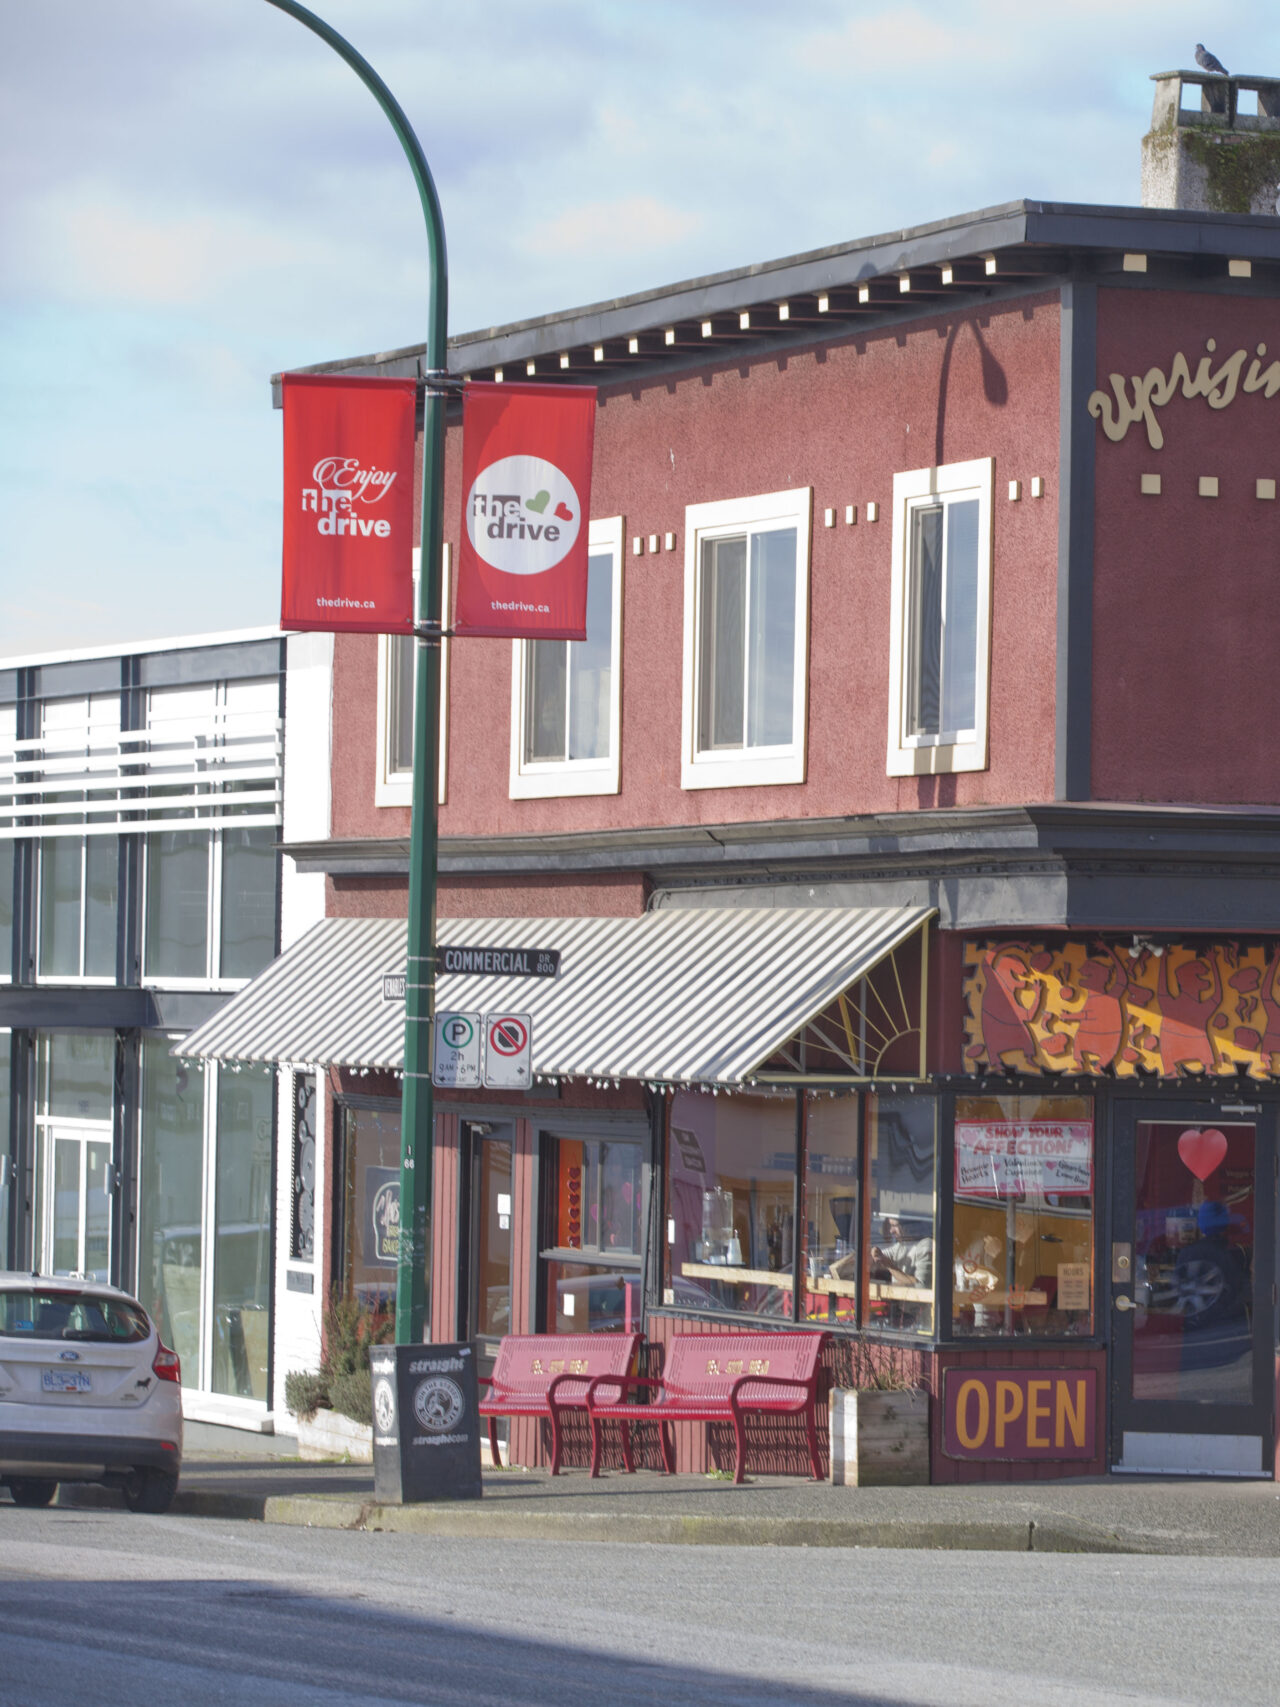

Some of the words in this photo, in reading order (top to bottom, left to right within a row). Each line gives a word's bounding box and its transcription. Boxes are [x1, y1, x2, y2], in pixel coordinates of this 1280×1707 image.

[313, 457, 397, 504] Enjoy
[302, 488, 352, 513] the
[473, 494, 521, 517] the
[317, 512, 391, 537] drive
[487, 516, 560, 542] drive
[316, 597, 376, 609] thedrive.ca
[491, 601, 550, 613] thedrive.ca
[445, 950, 531, 973] COMMERCIAL
[453, 1024, 466, 1041] P
[1027, 1127, 1064, 1139] YOUR
[956, 1379, 1086, 1449] OPEN
